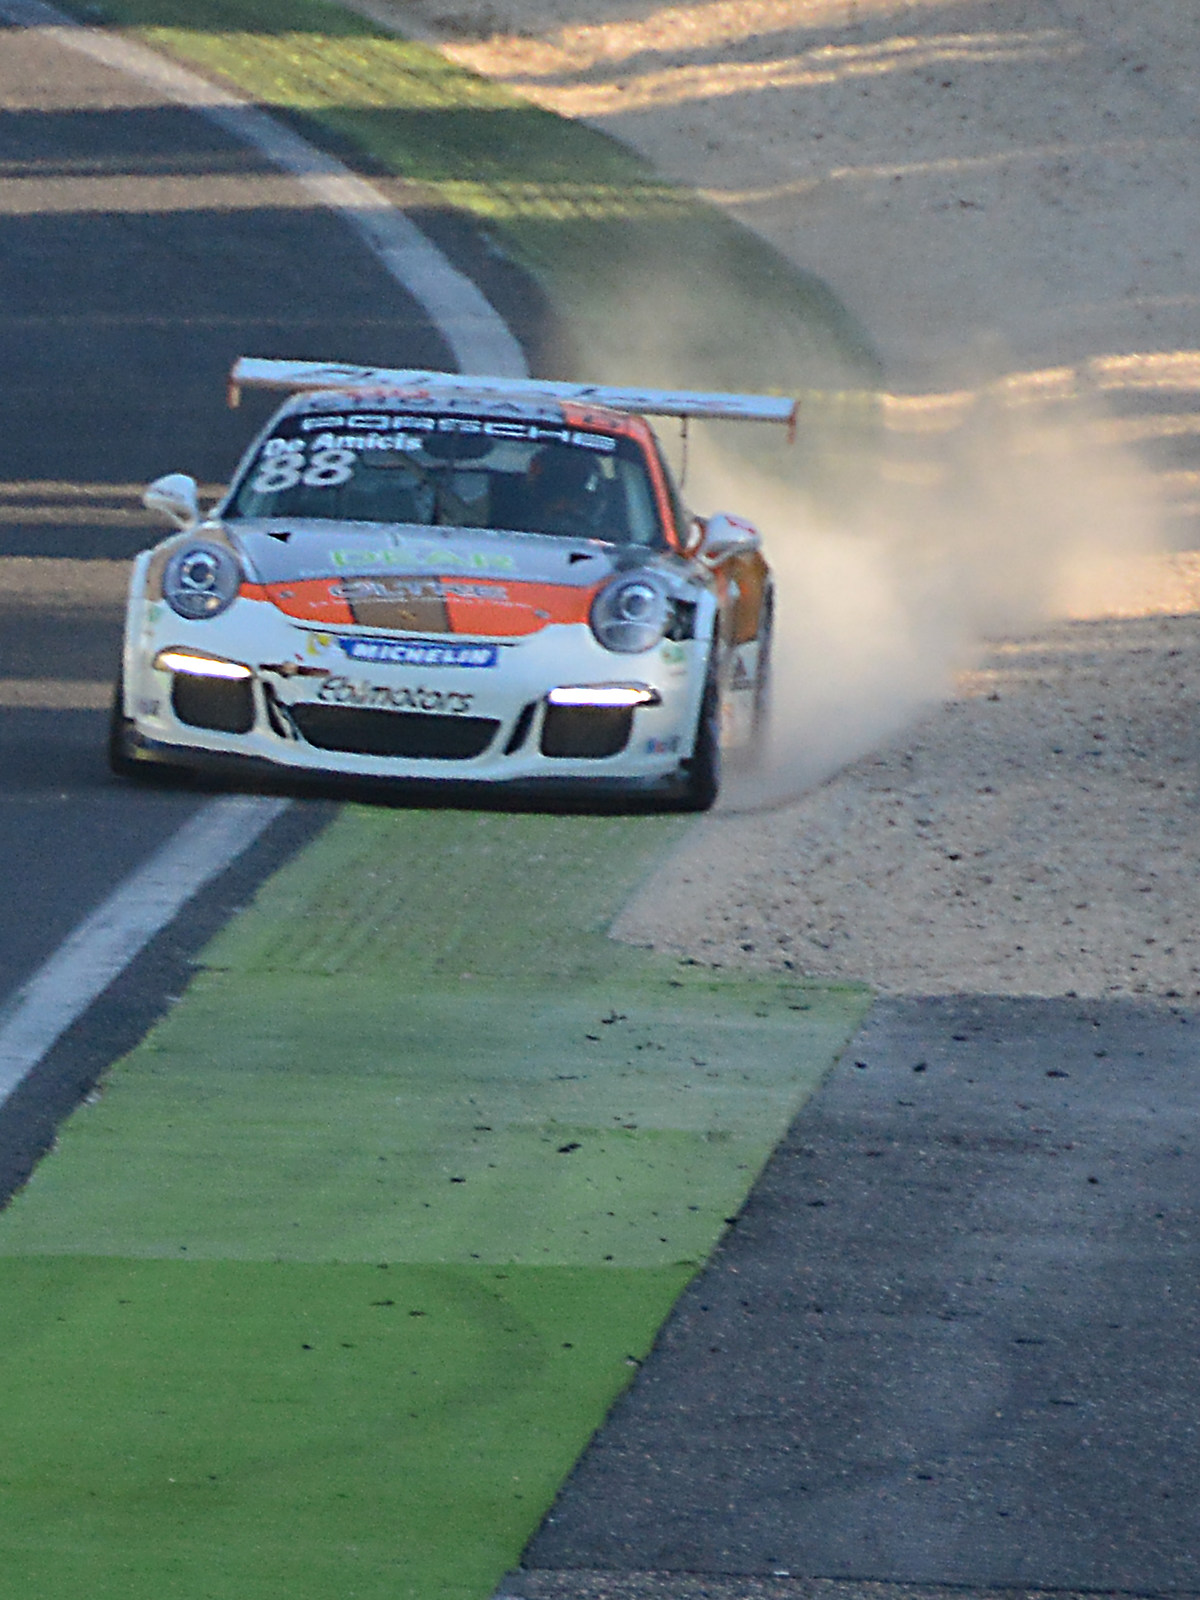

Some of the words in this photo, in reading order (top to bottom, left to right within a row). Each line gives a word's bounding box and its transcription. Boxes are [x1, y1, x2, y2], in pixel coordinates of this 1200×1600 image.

[302, 415, 616, 451] PORSCHE
[251, 450, 357, 493] 88
[351, 643, 492, 664] MICHELIN
